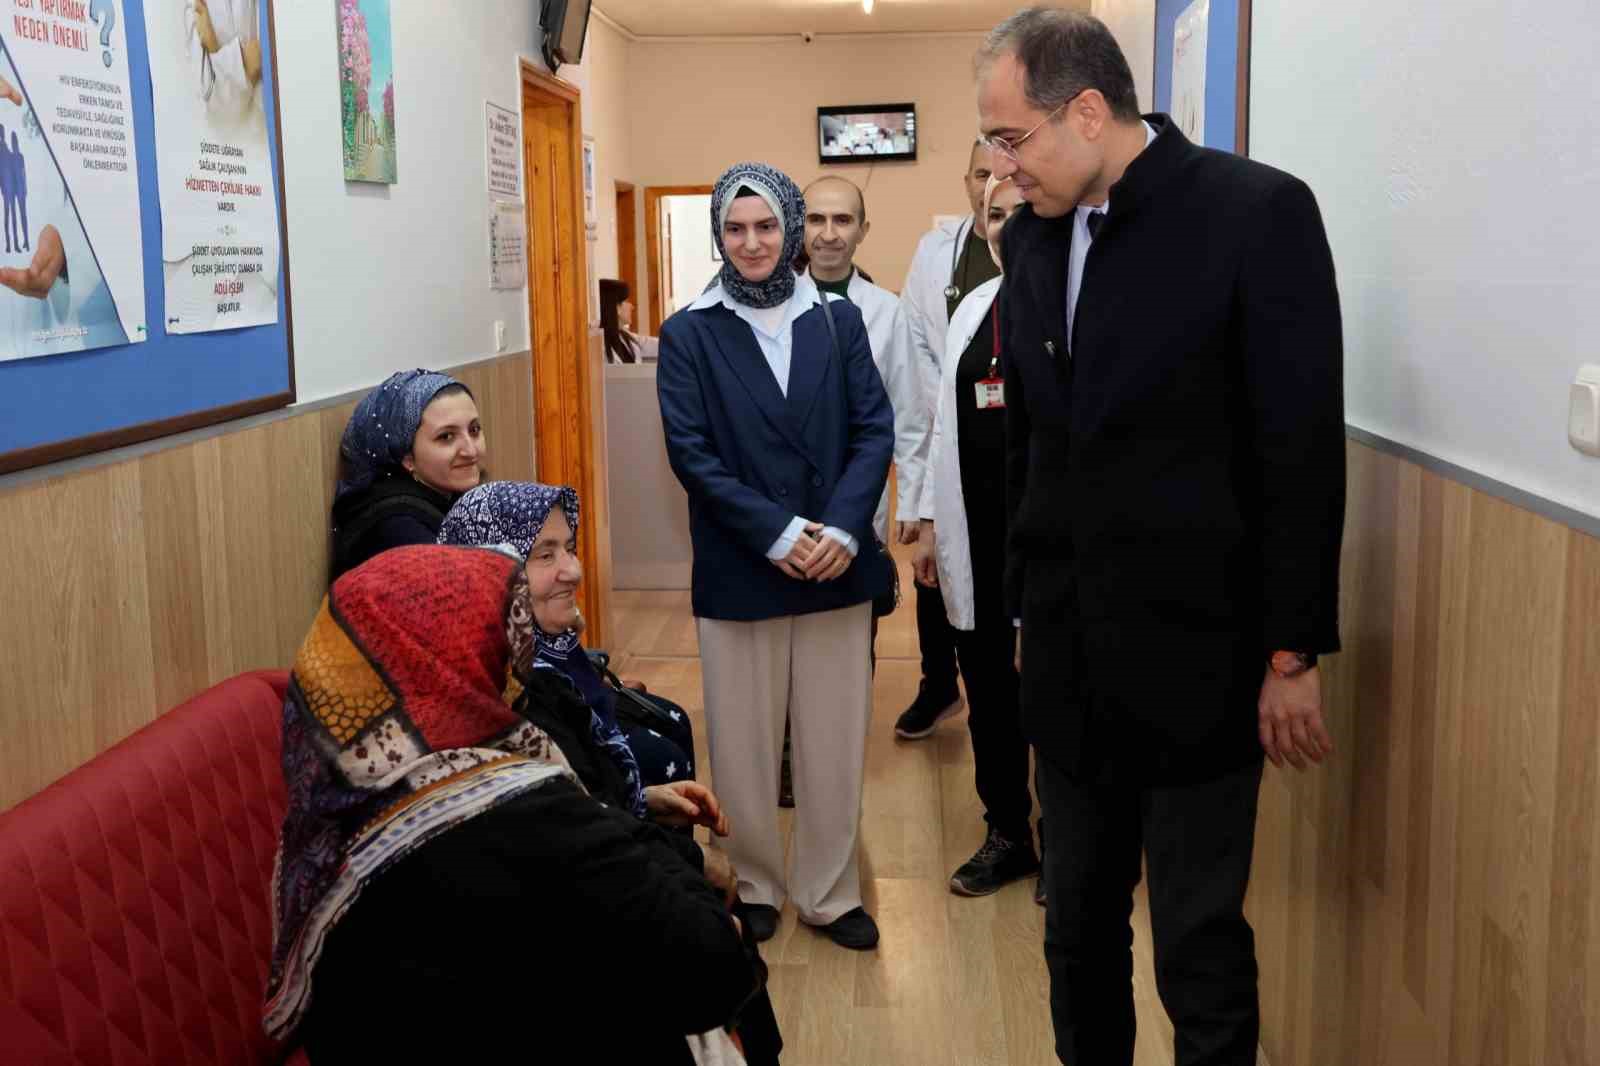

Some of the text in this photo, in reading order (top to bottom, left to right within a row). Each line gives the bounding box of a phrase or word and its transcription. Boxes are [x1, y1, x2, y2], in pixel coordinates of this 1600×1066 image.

[14, 14, 88, 52] NEDEN ÖNEMLİ
[199, 159, 216, 171] SAĞLIK
[185, 176, 219, 193] HİZMETTEN
[210, 245, 239, 257] UYGULAYAN
[192, 263, 213, 276] ÇALIŞAN
